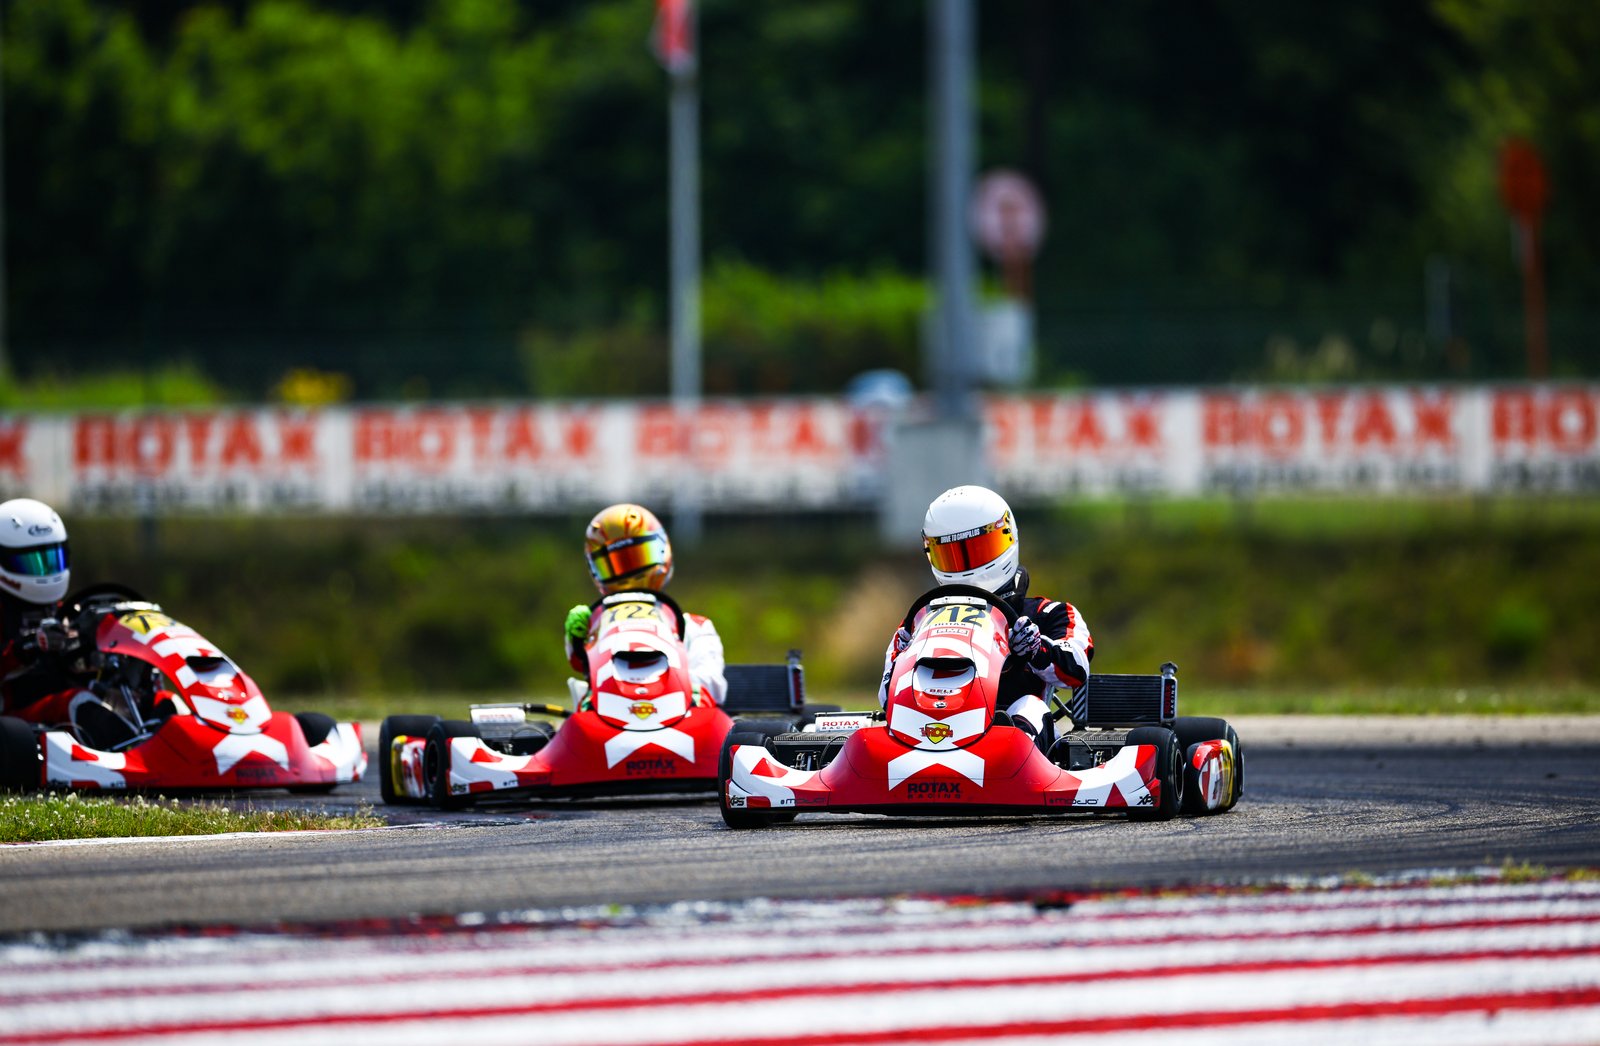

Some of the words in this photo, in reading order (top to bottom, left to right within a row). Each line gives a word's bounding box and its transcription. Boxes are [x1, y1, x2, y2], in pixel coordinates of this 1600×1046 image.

[1201, 394, 1457, 456] ROTAX
[940, 535, 952, 544] DRIVE
[626, 758, 674, 770] ROTAX
[907, 782, 961, 793] ROTAX
